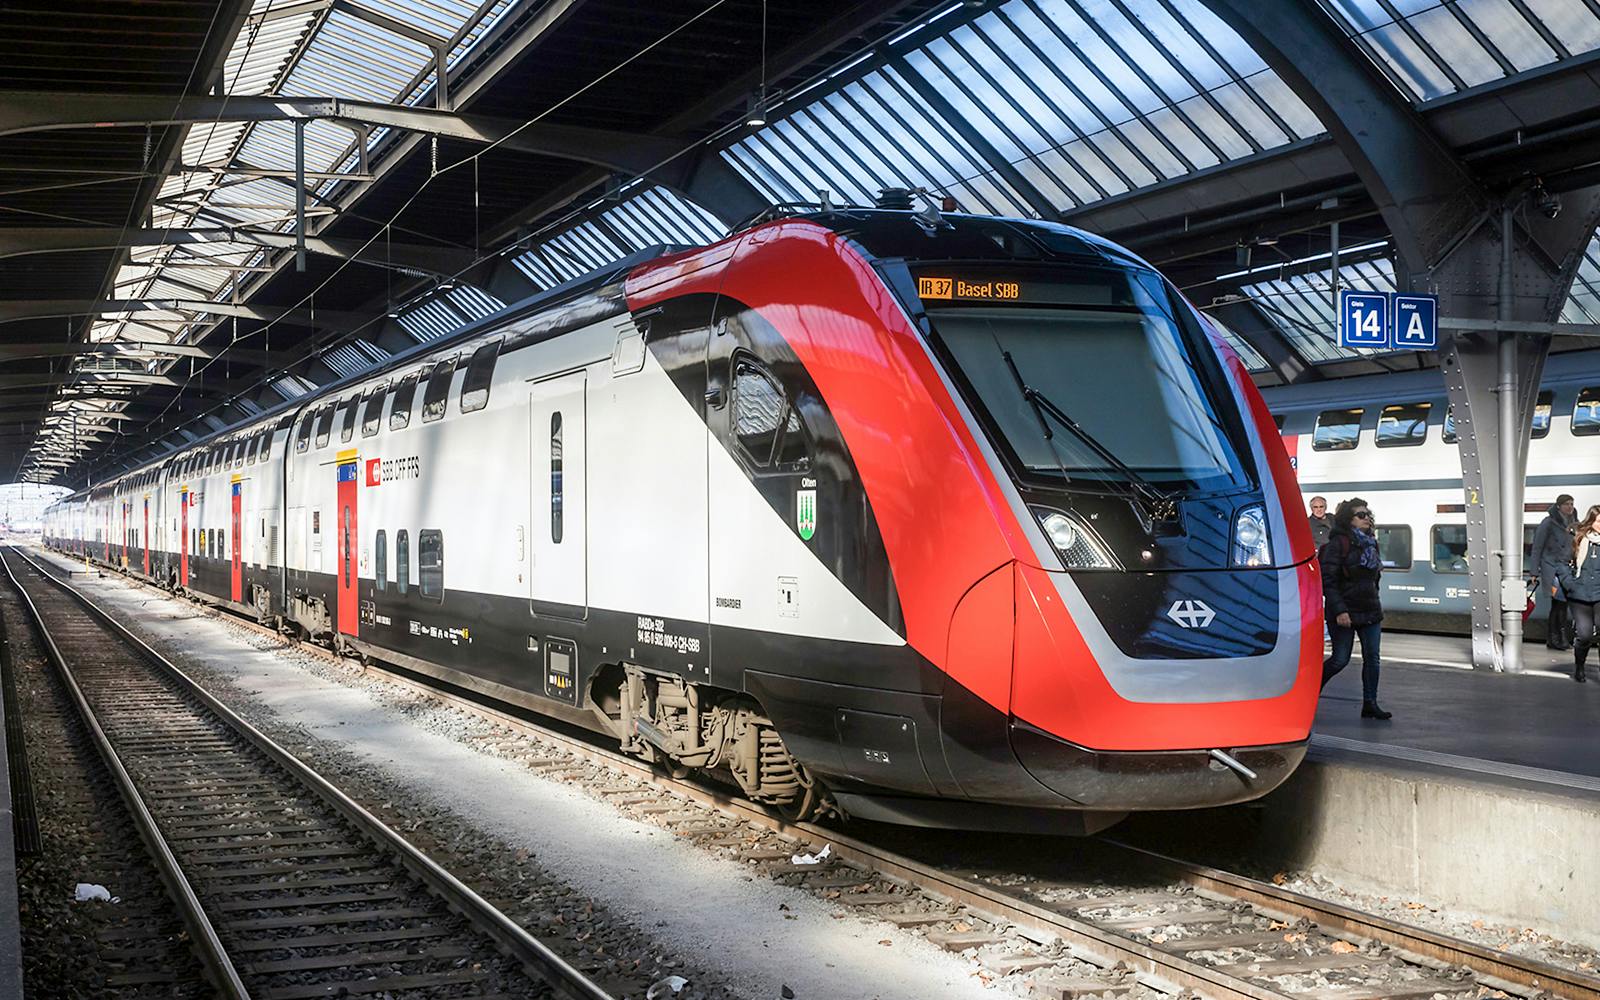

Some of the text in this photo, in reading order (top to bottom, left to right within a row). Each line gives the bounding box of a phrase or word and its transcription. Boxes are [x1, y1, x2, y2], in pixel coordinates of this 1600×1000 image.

[921, 280, 1019, 299] IR 37 Basel SBB
[1351, 309, 1381, 337] 14
[1405, 312, 1426, 340] A
[382, 456, 420, 482] SBB CFF FFS
[801, 477, 817, 488] Olten
[1471, 491, 1478, 504] 2
[716, 597, 742, 609] BOMBARDIER
[655, 619, 665, 632] 502
[637, 629, 644, 643] 94
[655, 632, 664, 646] 502
[678, 636, 701, 653] CH-SBB
